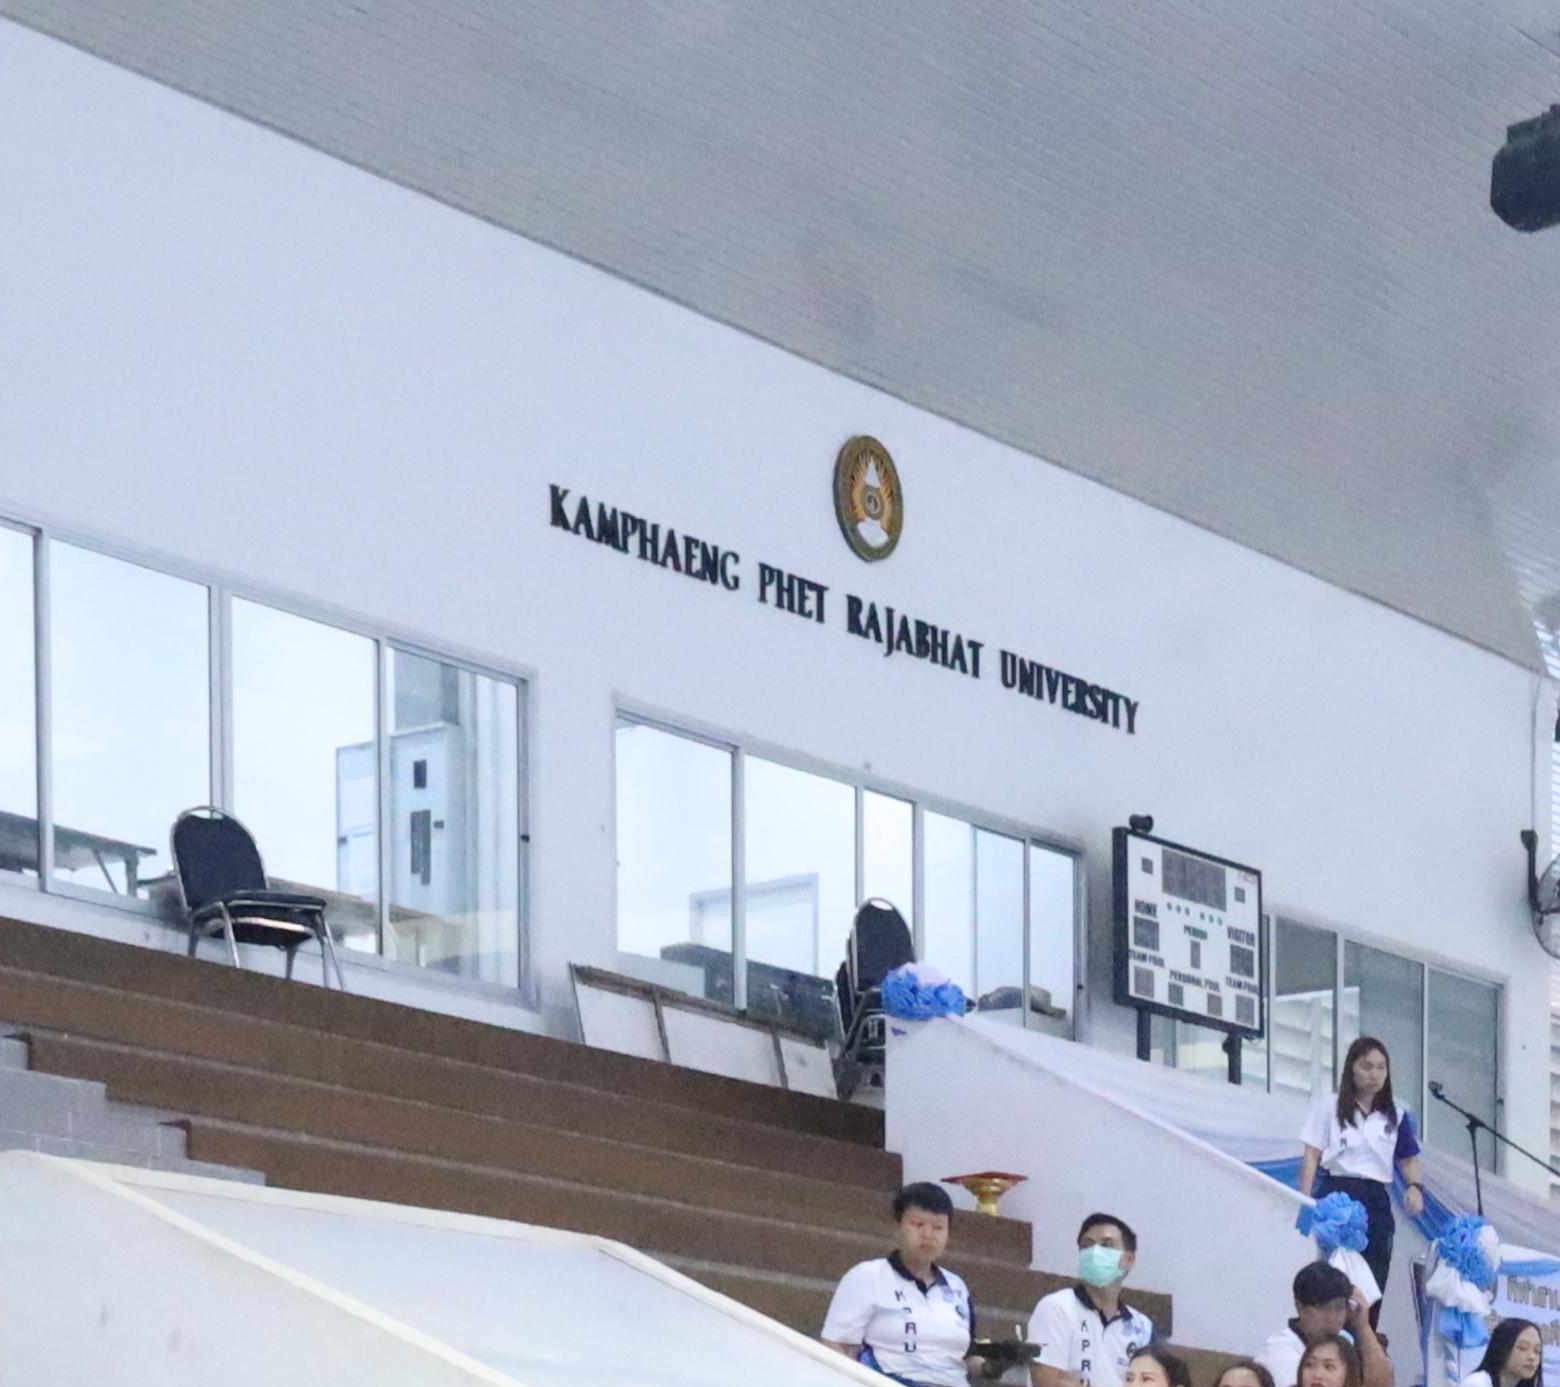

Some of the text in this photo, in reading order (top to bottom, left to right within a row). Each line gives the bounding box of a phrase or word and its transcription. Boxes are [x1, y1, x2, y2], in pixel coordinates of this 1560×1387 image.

[548, 484, 1140, 735] KAMPHAENG PHET RAJABHAT UNIVERSITY
[1227, 926, 1255, 947] VISITOR
